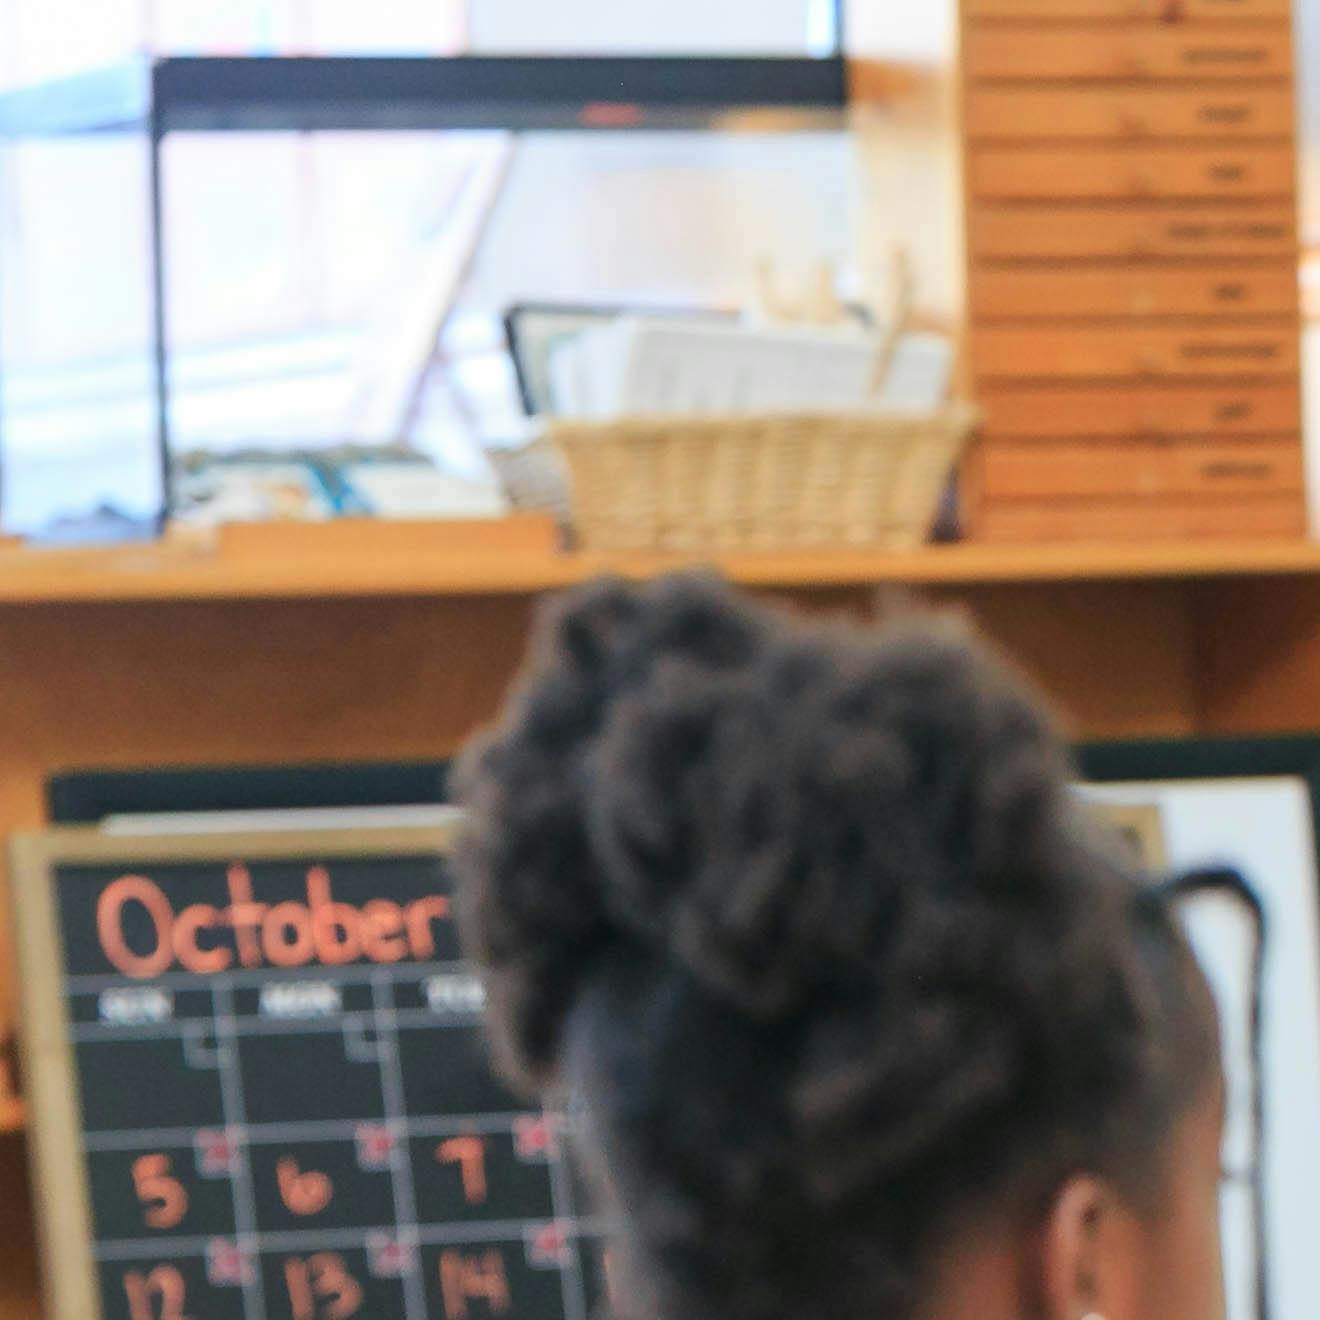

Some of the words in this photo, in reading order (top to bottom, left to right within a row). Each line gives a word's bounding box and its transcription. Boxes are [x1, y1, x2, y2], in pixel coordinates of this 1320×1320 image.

[96, 862, 452, 978] October
[130, 1152, 188, 1229] 5
[275, 1155, 332, 1216] 6
[435, 1133, 487, 1204] 7
